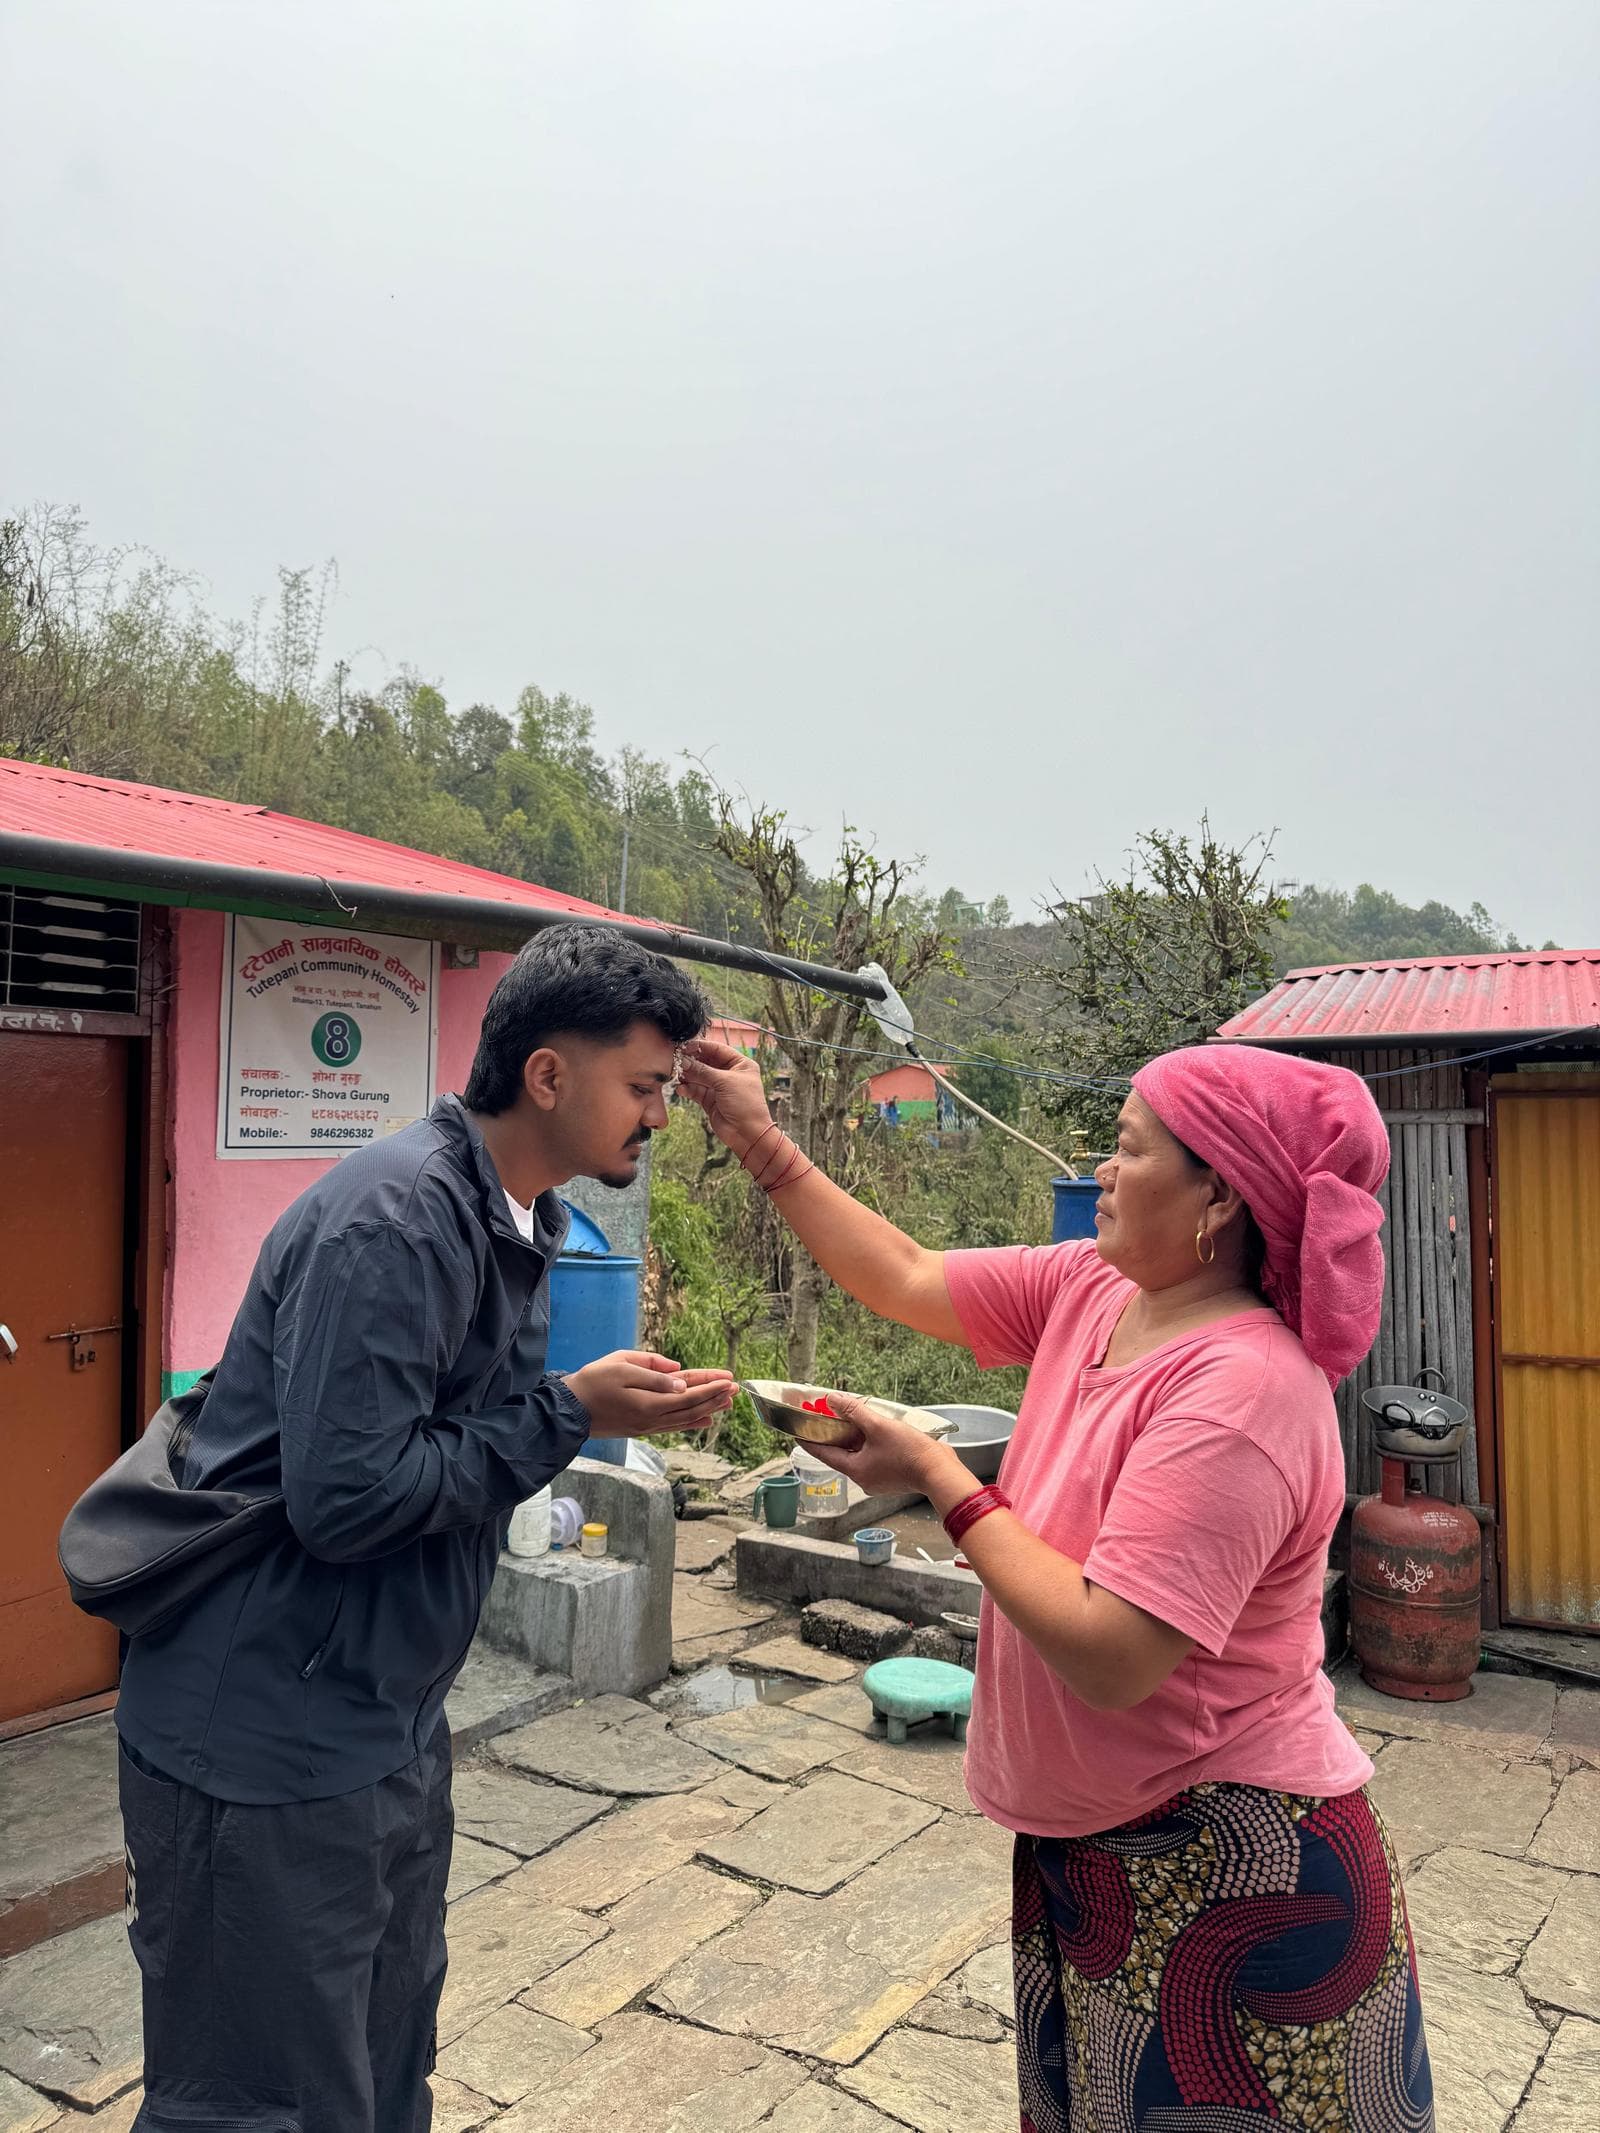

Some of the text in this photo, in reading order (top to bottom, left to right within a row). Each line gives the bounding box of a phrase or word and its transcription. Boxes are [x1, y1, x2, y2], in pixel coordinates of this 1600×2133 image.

[239, 937, 426, 997] टुटेपानी सामुदायिक होमस्टे
[246, 960, 420, 1014] Tutepani Community Homestay
[324, 1017, 351, 1061] 8
[240, 1086, 390, 1103] Proprietor:- Shova Gurung
[239, 1127, 374, 1138] Mobile:- 9846296382
